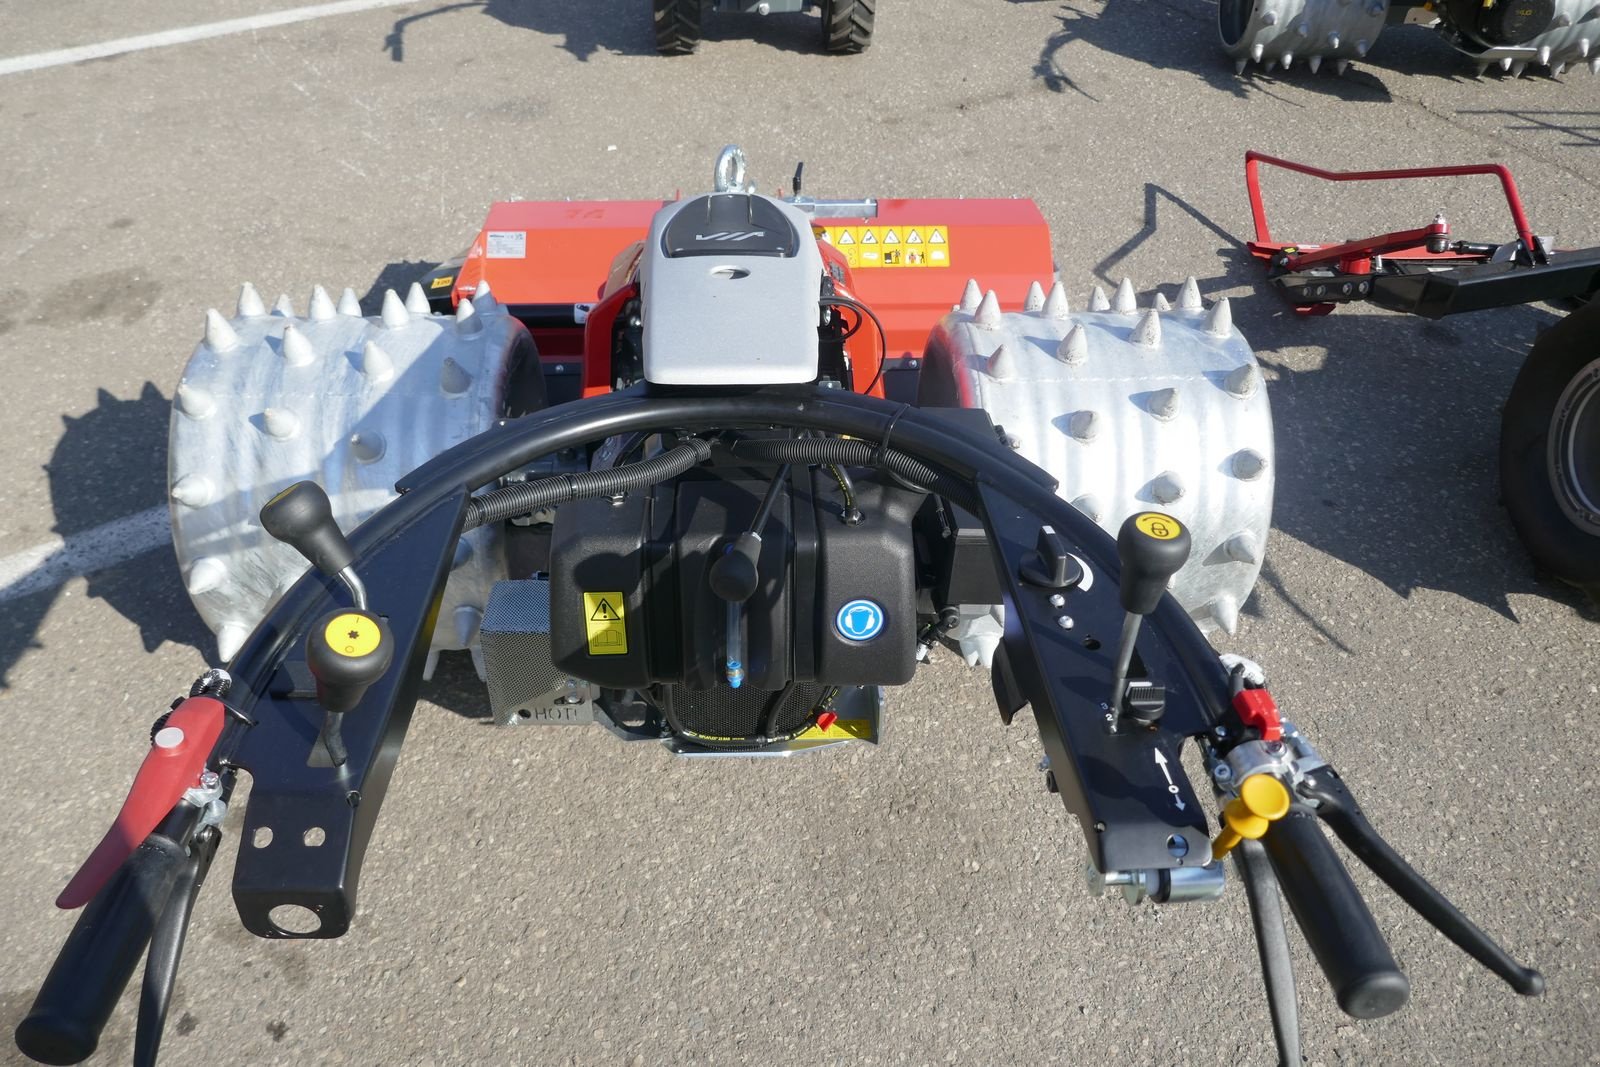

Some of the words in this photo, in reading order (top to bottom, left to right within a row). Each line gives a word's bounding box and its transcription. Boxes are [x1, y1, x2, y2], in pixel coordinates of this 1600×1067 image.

[1100, 702, 1109, 710] 3
[534, 707, 578, 722] HOT!
[1105, 713, 1114, 721] 2
